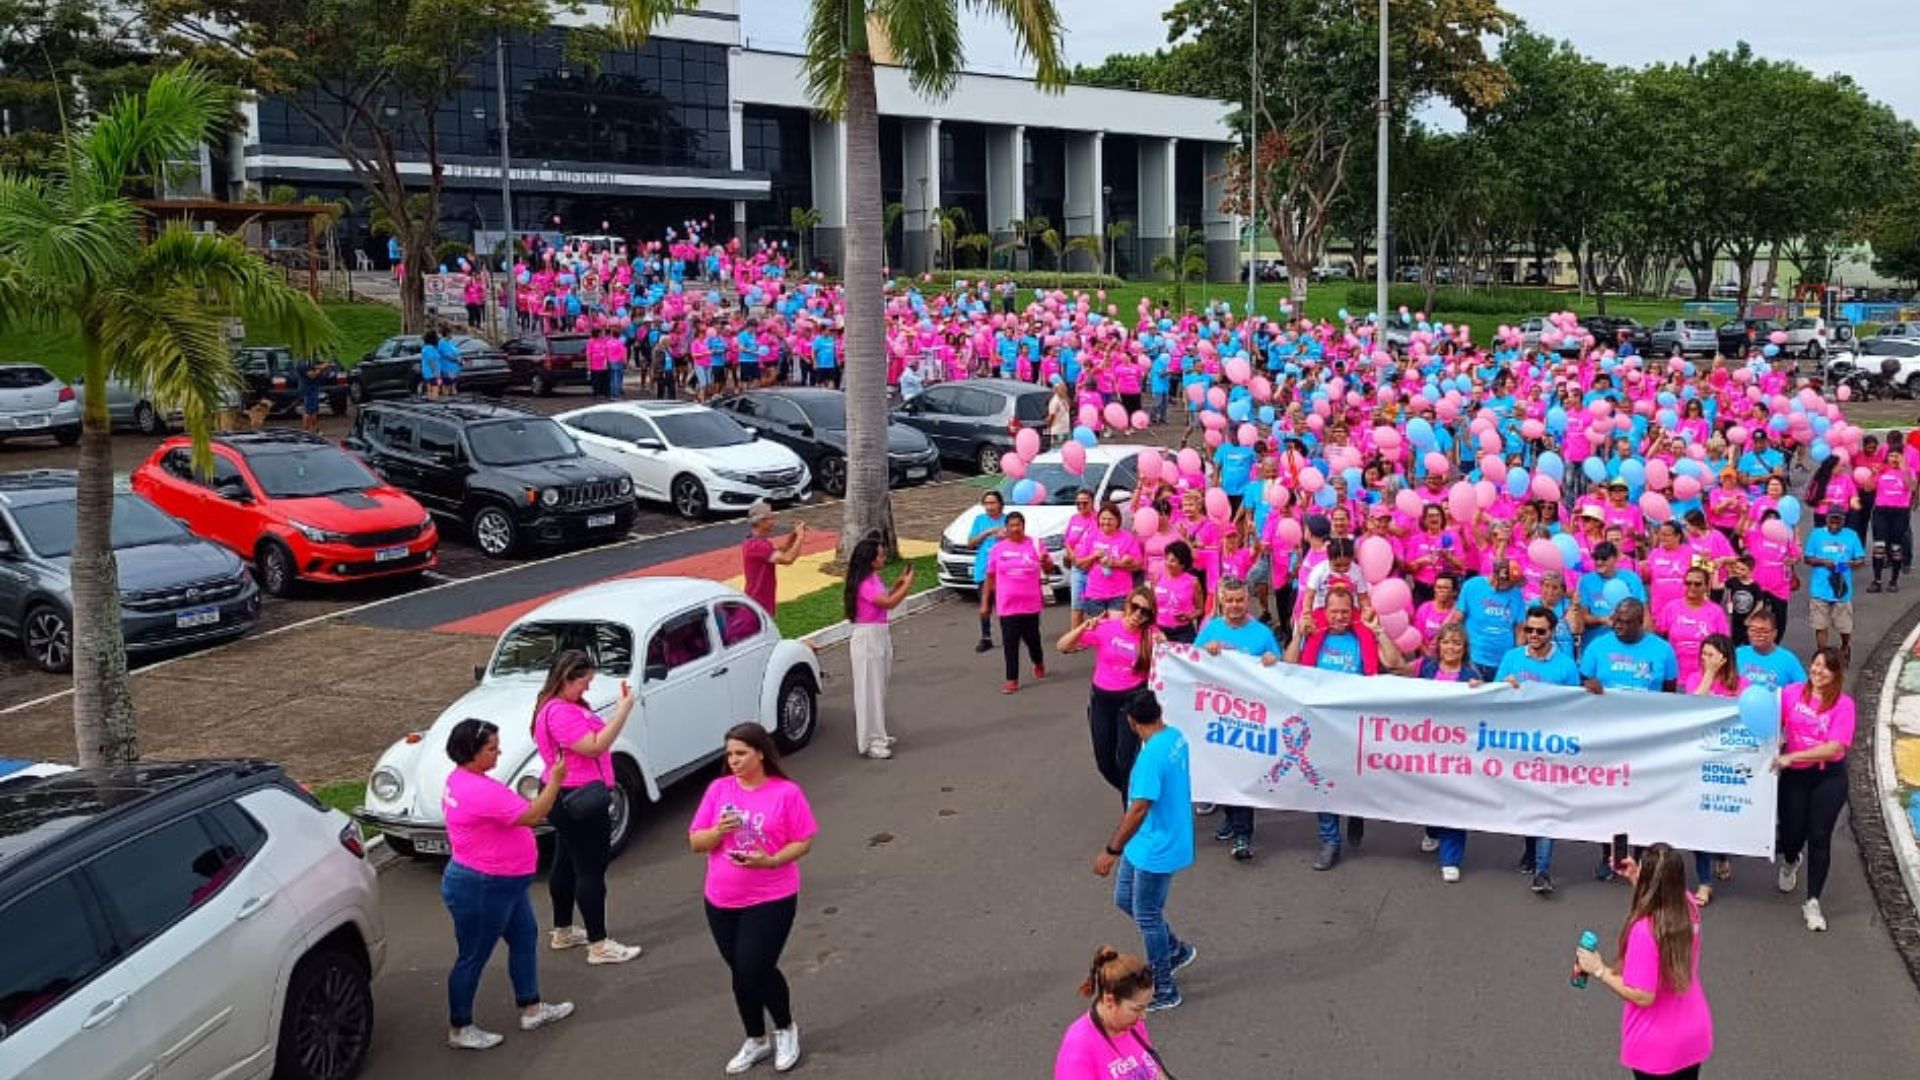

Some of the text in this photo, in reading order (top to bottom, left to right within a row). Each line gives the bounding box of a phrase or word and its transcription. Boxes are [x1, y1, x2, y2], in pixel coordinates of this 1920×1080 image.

[1194, 687, 1267, 724] rosa
[1205, 721, 1278, 756] azul
[1369, 717, 1581, 755] Todos juntos
[1367, 751, 1631, 787] contra o câncer!
